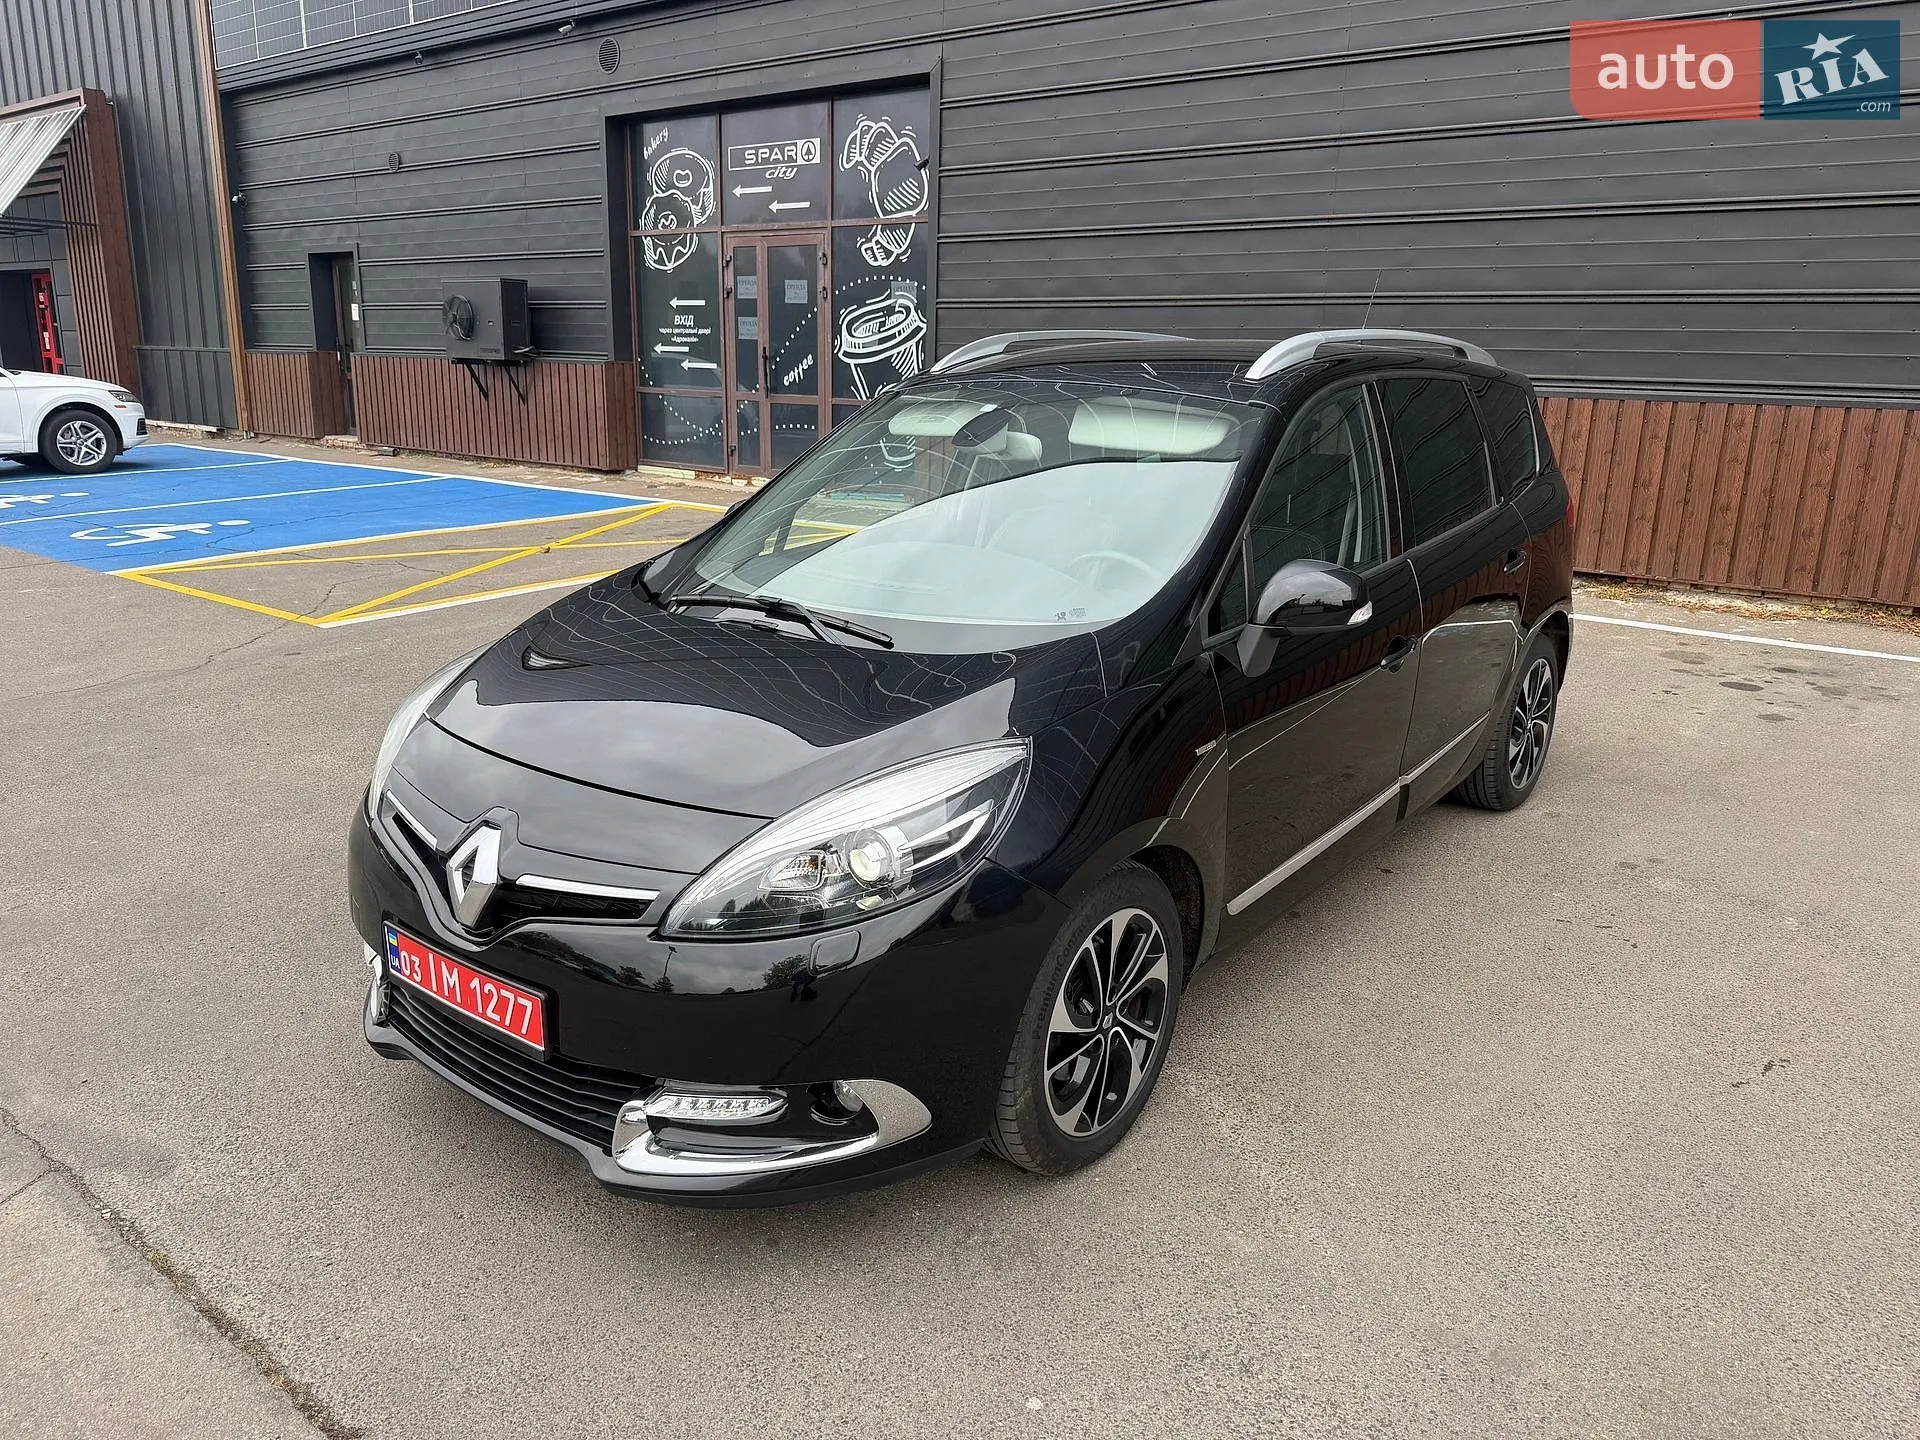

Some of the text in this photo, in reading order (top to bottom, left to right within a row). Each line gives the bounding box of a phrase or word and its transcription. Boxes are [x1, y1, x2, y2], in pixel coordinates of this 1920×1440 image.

[643, 127, 669, 160] bakery
[744, 145, 797, 164] SPAR
[765, 166, 798, 180] city
[674, 314, 694, 327] ВХІД
[783, 353, 814, 386] coffee
[390, 954, 401, 969] UA
[400, 950, 533, 1035] 03 IM 1277
